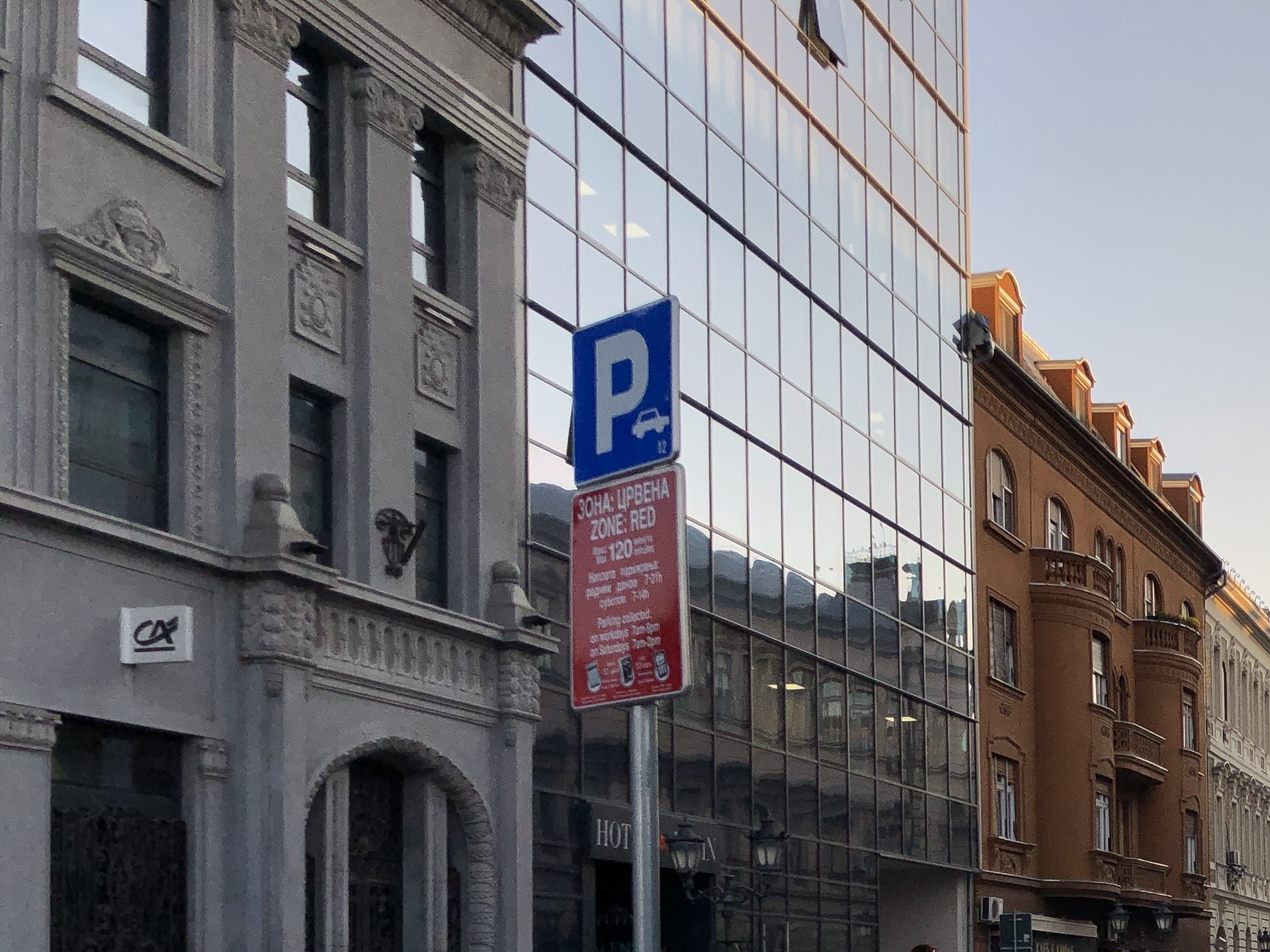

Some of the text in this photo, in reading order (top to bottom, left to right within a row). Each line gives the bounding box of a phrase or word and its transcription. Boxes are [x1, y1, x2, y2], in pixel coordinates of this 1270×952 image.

[596, 329, 649, 456] P
[577, 477, 670, 520] ЗОНА: ЦРВЕНА
[590, 505, 656, 541] ZONE: RED
[608, 538, 633, 561] 120
[596, 818, 633, 850] HOT
